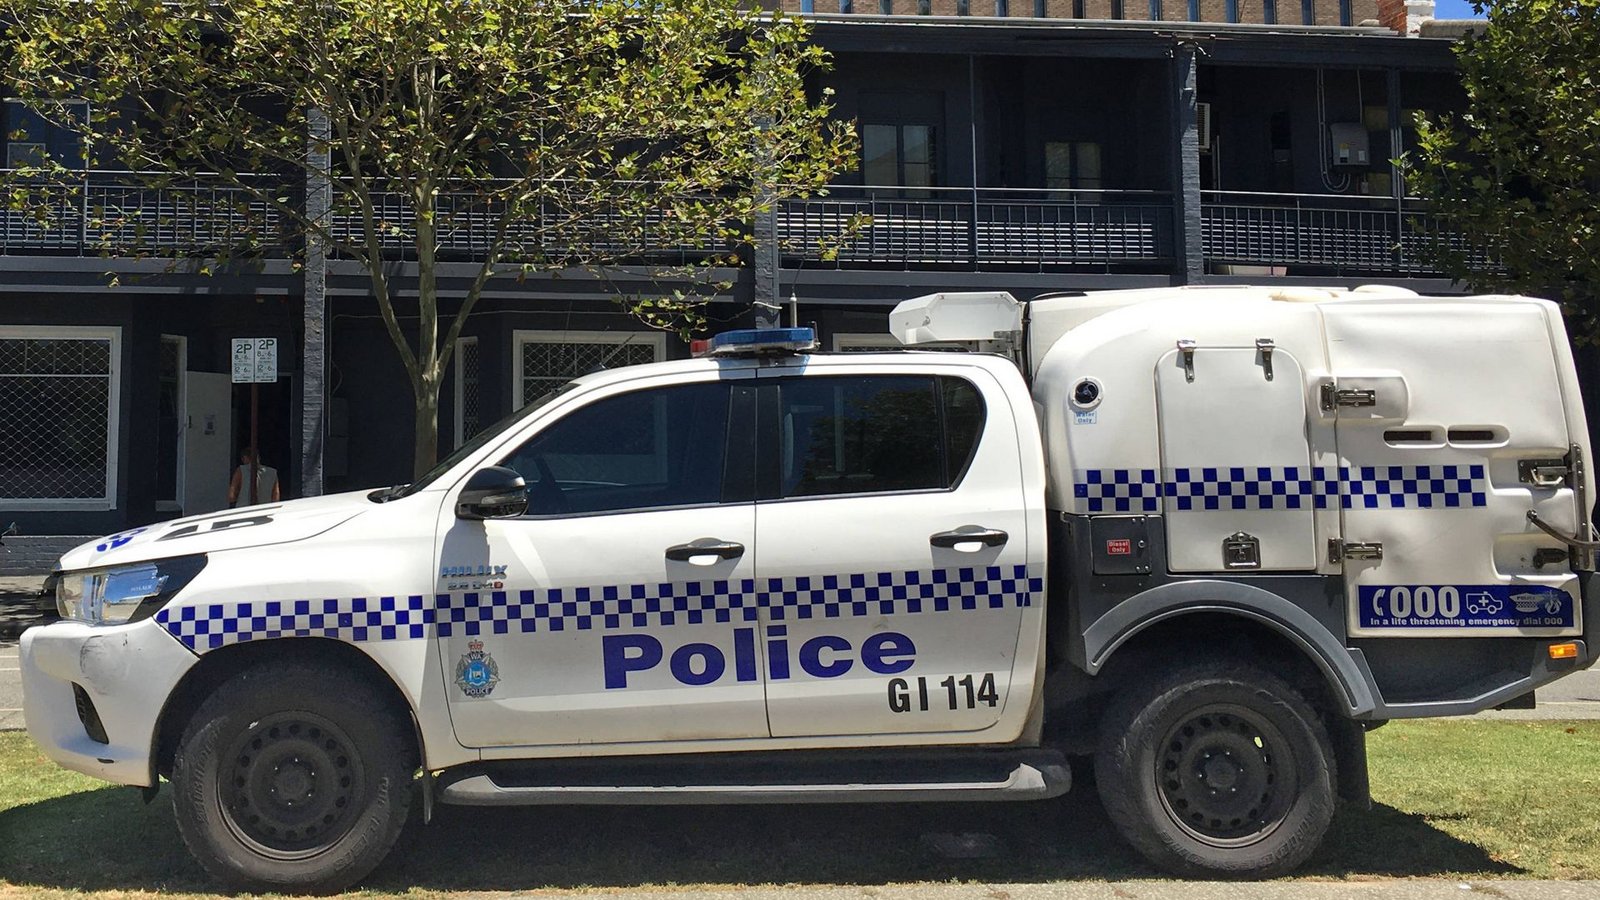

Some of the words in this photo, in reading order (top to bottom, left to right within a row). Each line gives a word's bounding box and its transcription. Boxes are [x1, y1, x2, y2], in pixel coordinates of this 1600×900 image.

[236, 343, 253, 354] 2P
[258, 339, 275, 350] 2P
[1389, 586, 1460, 618] 000
[1410, 618, 1466, 627] threatening
[1468, 618, 1520, 627] emergency
[1523, 617, 1542, 625] dial
[602, 625, 916, 689] Police
[941, 673, 999, 710] 114
